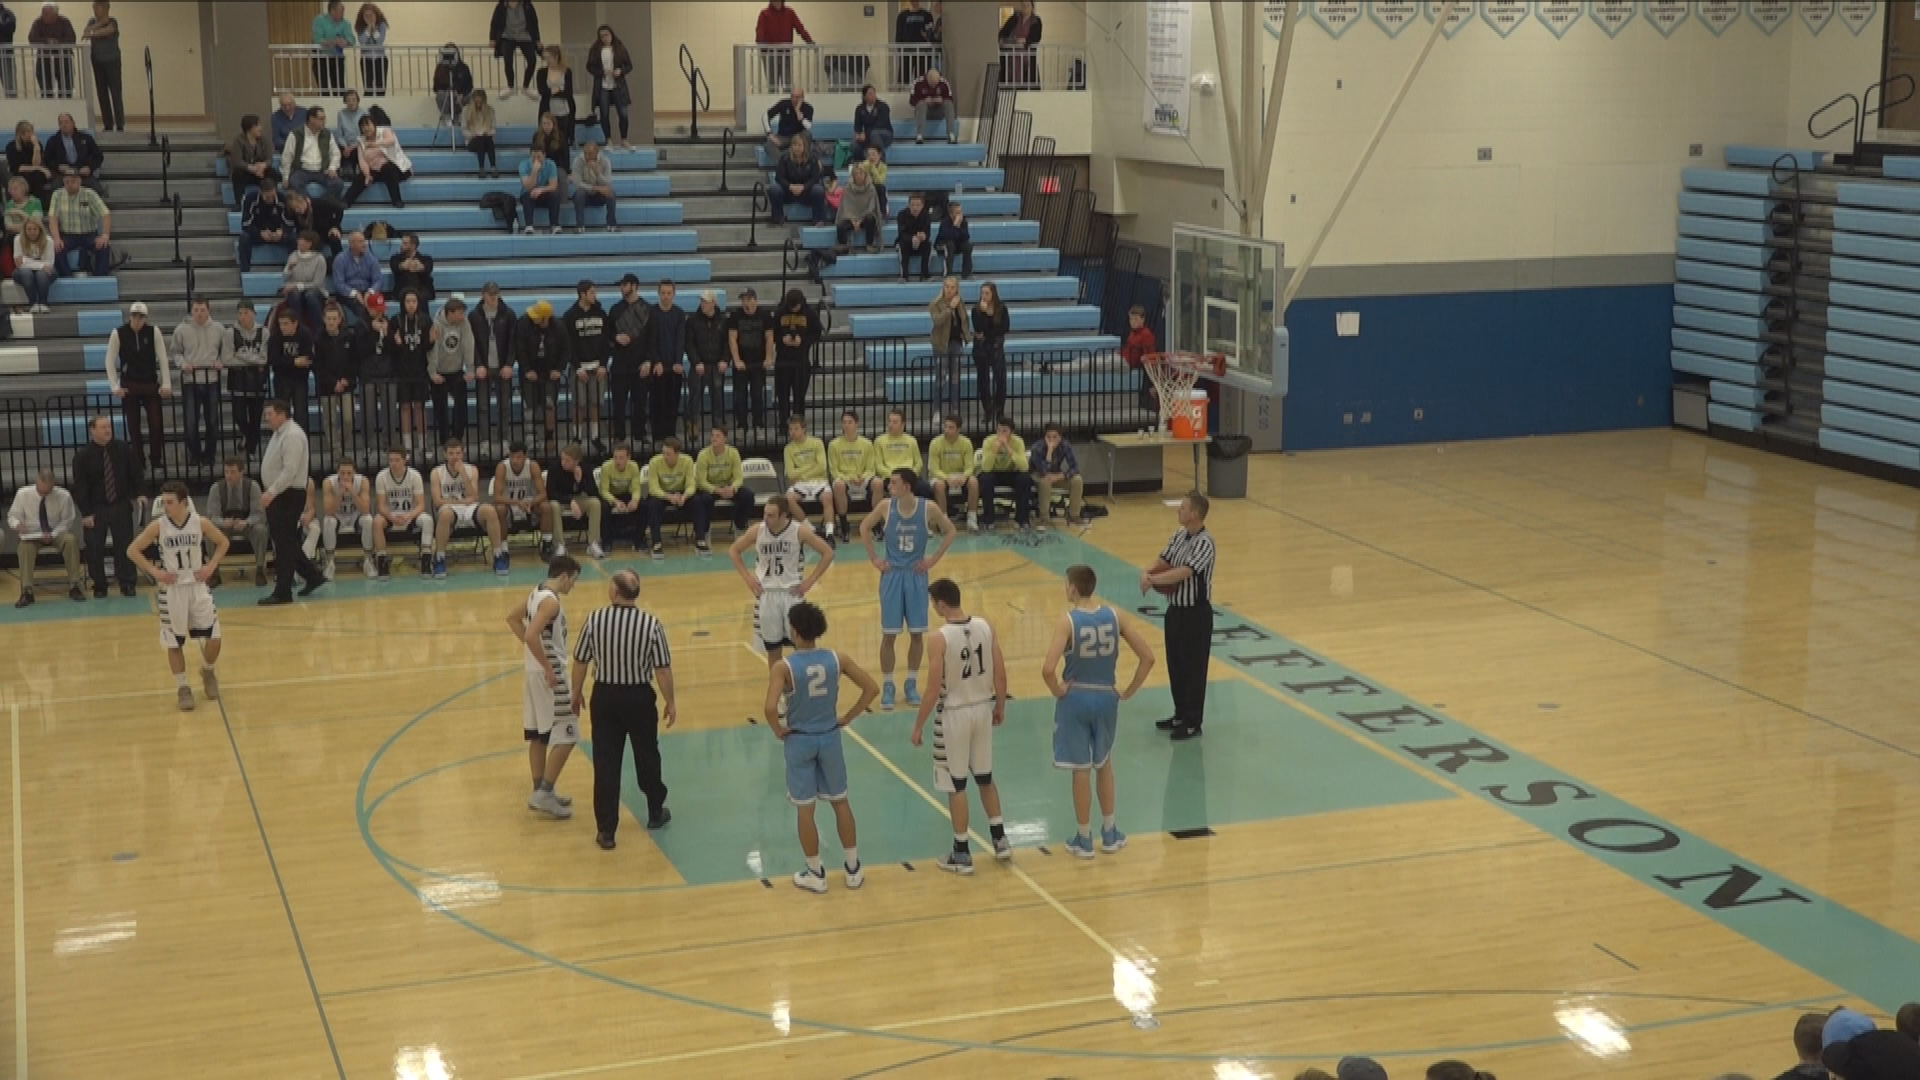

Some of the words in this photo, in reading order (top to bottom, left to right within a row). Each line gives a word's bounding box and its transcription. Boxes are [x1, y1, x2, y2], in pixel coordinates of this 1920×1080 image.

[898, 535, 915, 552] 15
[175, 547, 193, 571] 11
[764, 555, 785, 577] 15
[1079, 624, 1116, 659] 25
[960, 642, 986, 680] 21
[806, 663, 828, 698] 2
